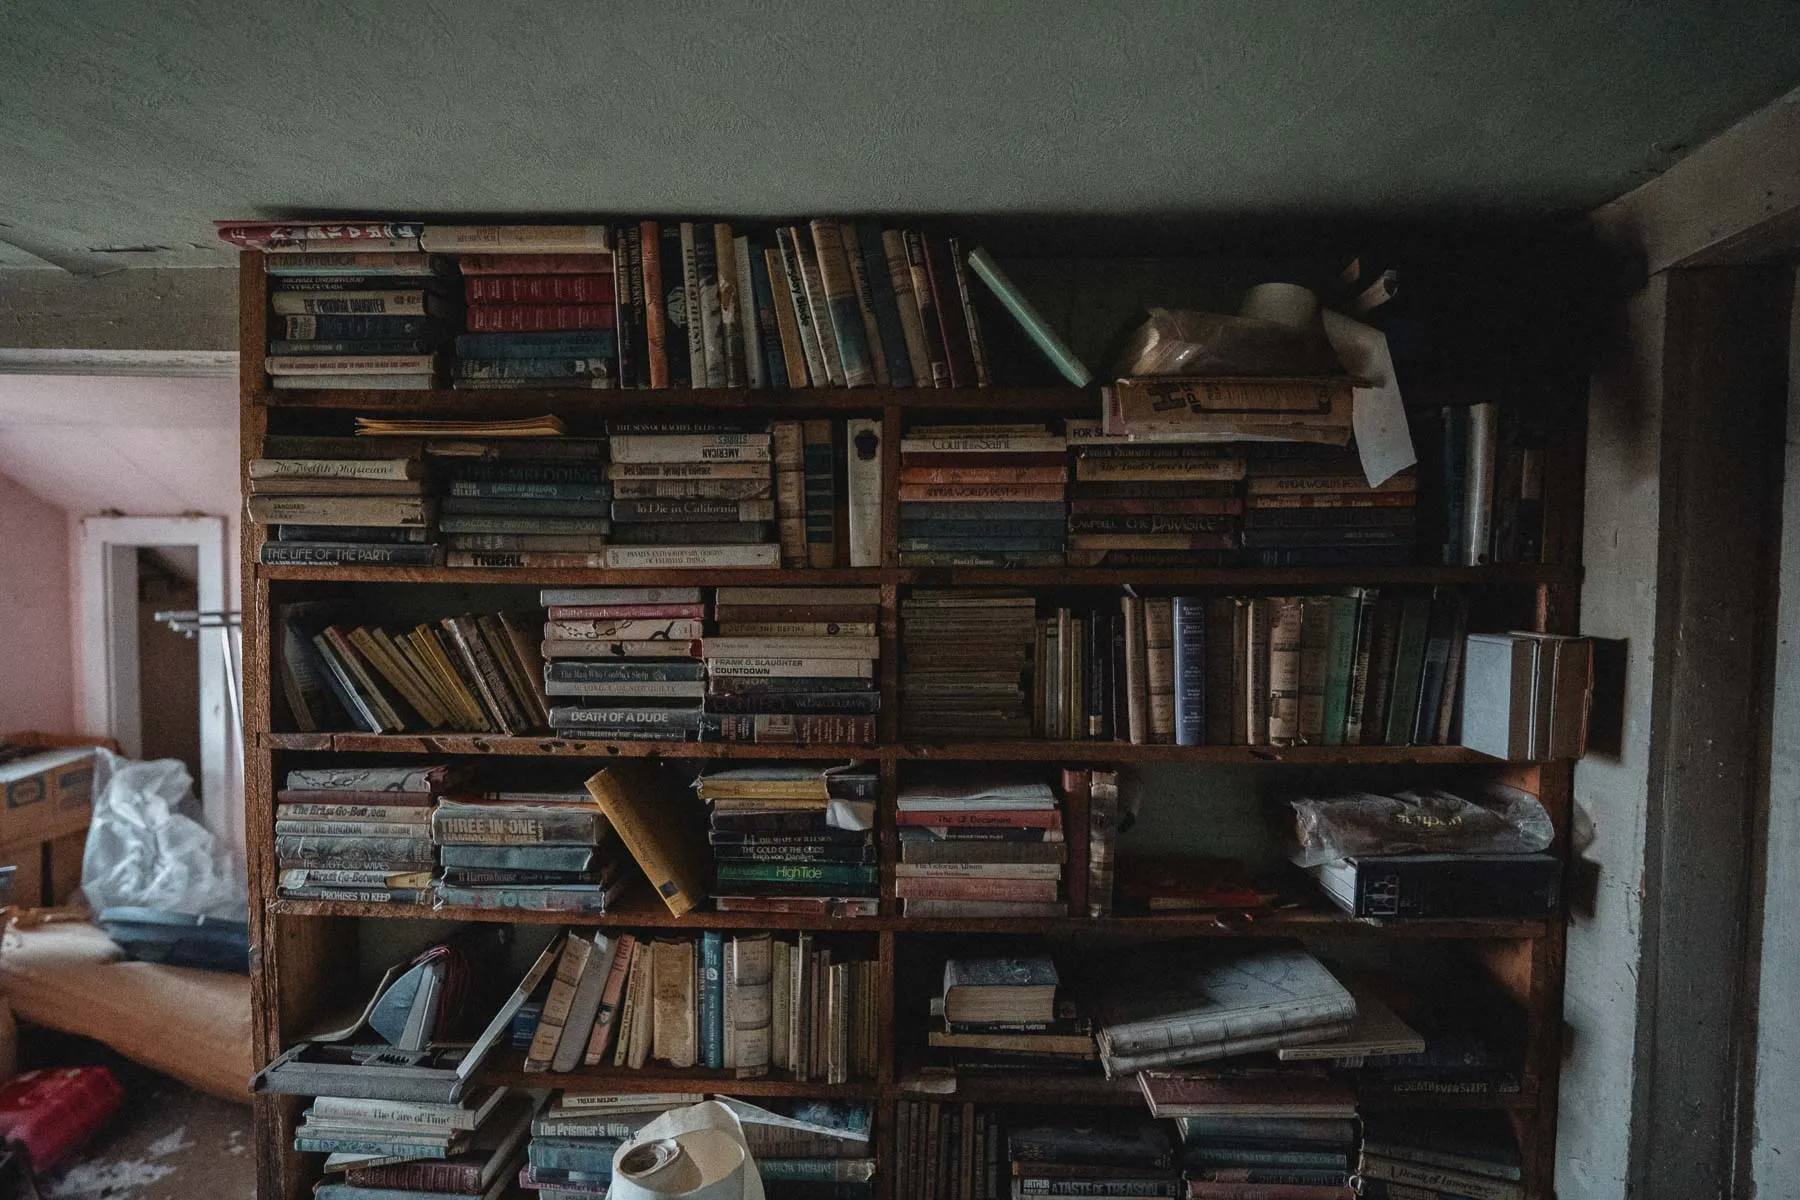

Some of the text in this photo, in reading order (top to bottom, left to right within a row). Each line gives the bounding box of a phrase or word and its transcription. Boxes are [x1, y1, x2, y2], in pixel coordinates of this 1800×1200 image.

[786, 249, 809, 327] Tuesday Blade
[349, 299, 386, 313] DAUGHTER
[1073, 428, 1091, 437] FOR
[932, 438, 1009, 450] Count Saint
[702, 447, 739, 459] AMERICAN
[273, 461, 388, 476] The Twelfth Physician
[649, 500, 668, 513] Die
[671, 502, 682, 513] in
[684, 500, 738, 513] California
[267, 547, 393, 562] THE LIFE OF THE PARTY
[471, 554, 521, 567] TRIBAL
[715, 667, 771, 675] COUNTDOWN
[571, 712, 669, 722] DEATH OF A DUDE
[292, 804, 334, 816] The Brass
[970, 816, 1011, 824] Document
[312, 825, 326, 834] THE
[327, 825, 362, 835] KINGDOM
[443, 833, 503, 843] HAMMOND
[756, 846, 778, 854] GOLD
[303, 860, 319, 869] THE
[363, 861, 390, 870] WIVES
[312, 873, 338, 883] Brass
[466, 871, 517, 882] Harrowhouse
[775, 865, 800, 880] High
[801, 866, 822, 878] Tide
[320, 891, 358, 900] PROMISES
[359, 892, 370, 900] TO
[371, 893, 391, 902] KEEP
[1403, 1082, 1434, 1092] DEATH
[1436, 1083, 1457, 1092] EVER
[1459, 1082, 1489, 1092] SLEPT
[373, 1109, 390, 1119] The
[391, 1110, 413, 1122] Care
[414, 1112, 426, 1123] of
[425, 1113, 450, 1125] Time
[540, 1123, 557, 1136] The
[607, 1123, 630, 1137] Wife
[1023, 1179, 1158, 1196] ARTHUR A TASTE OF TREASON
